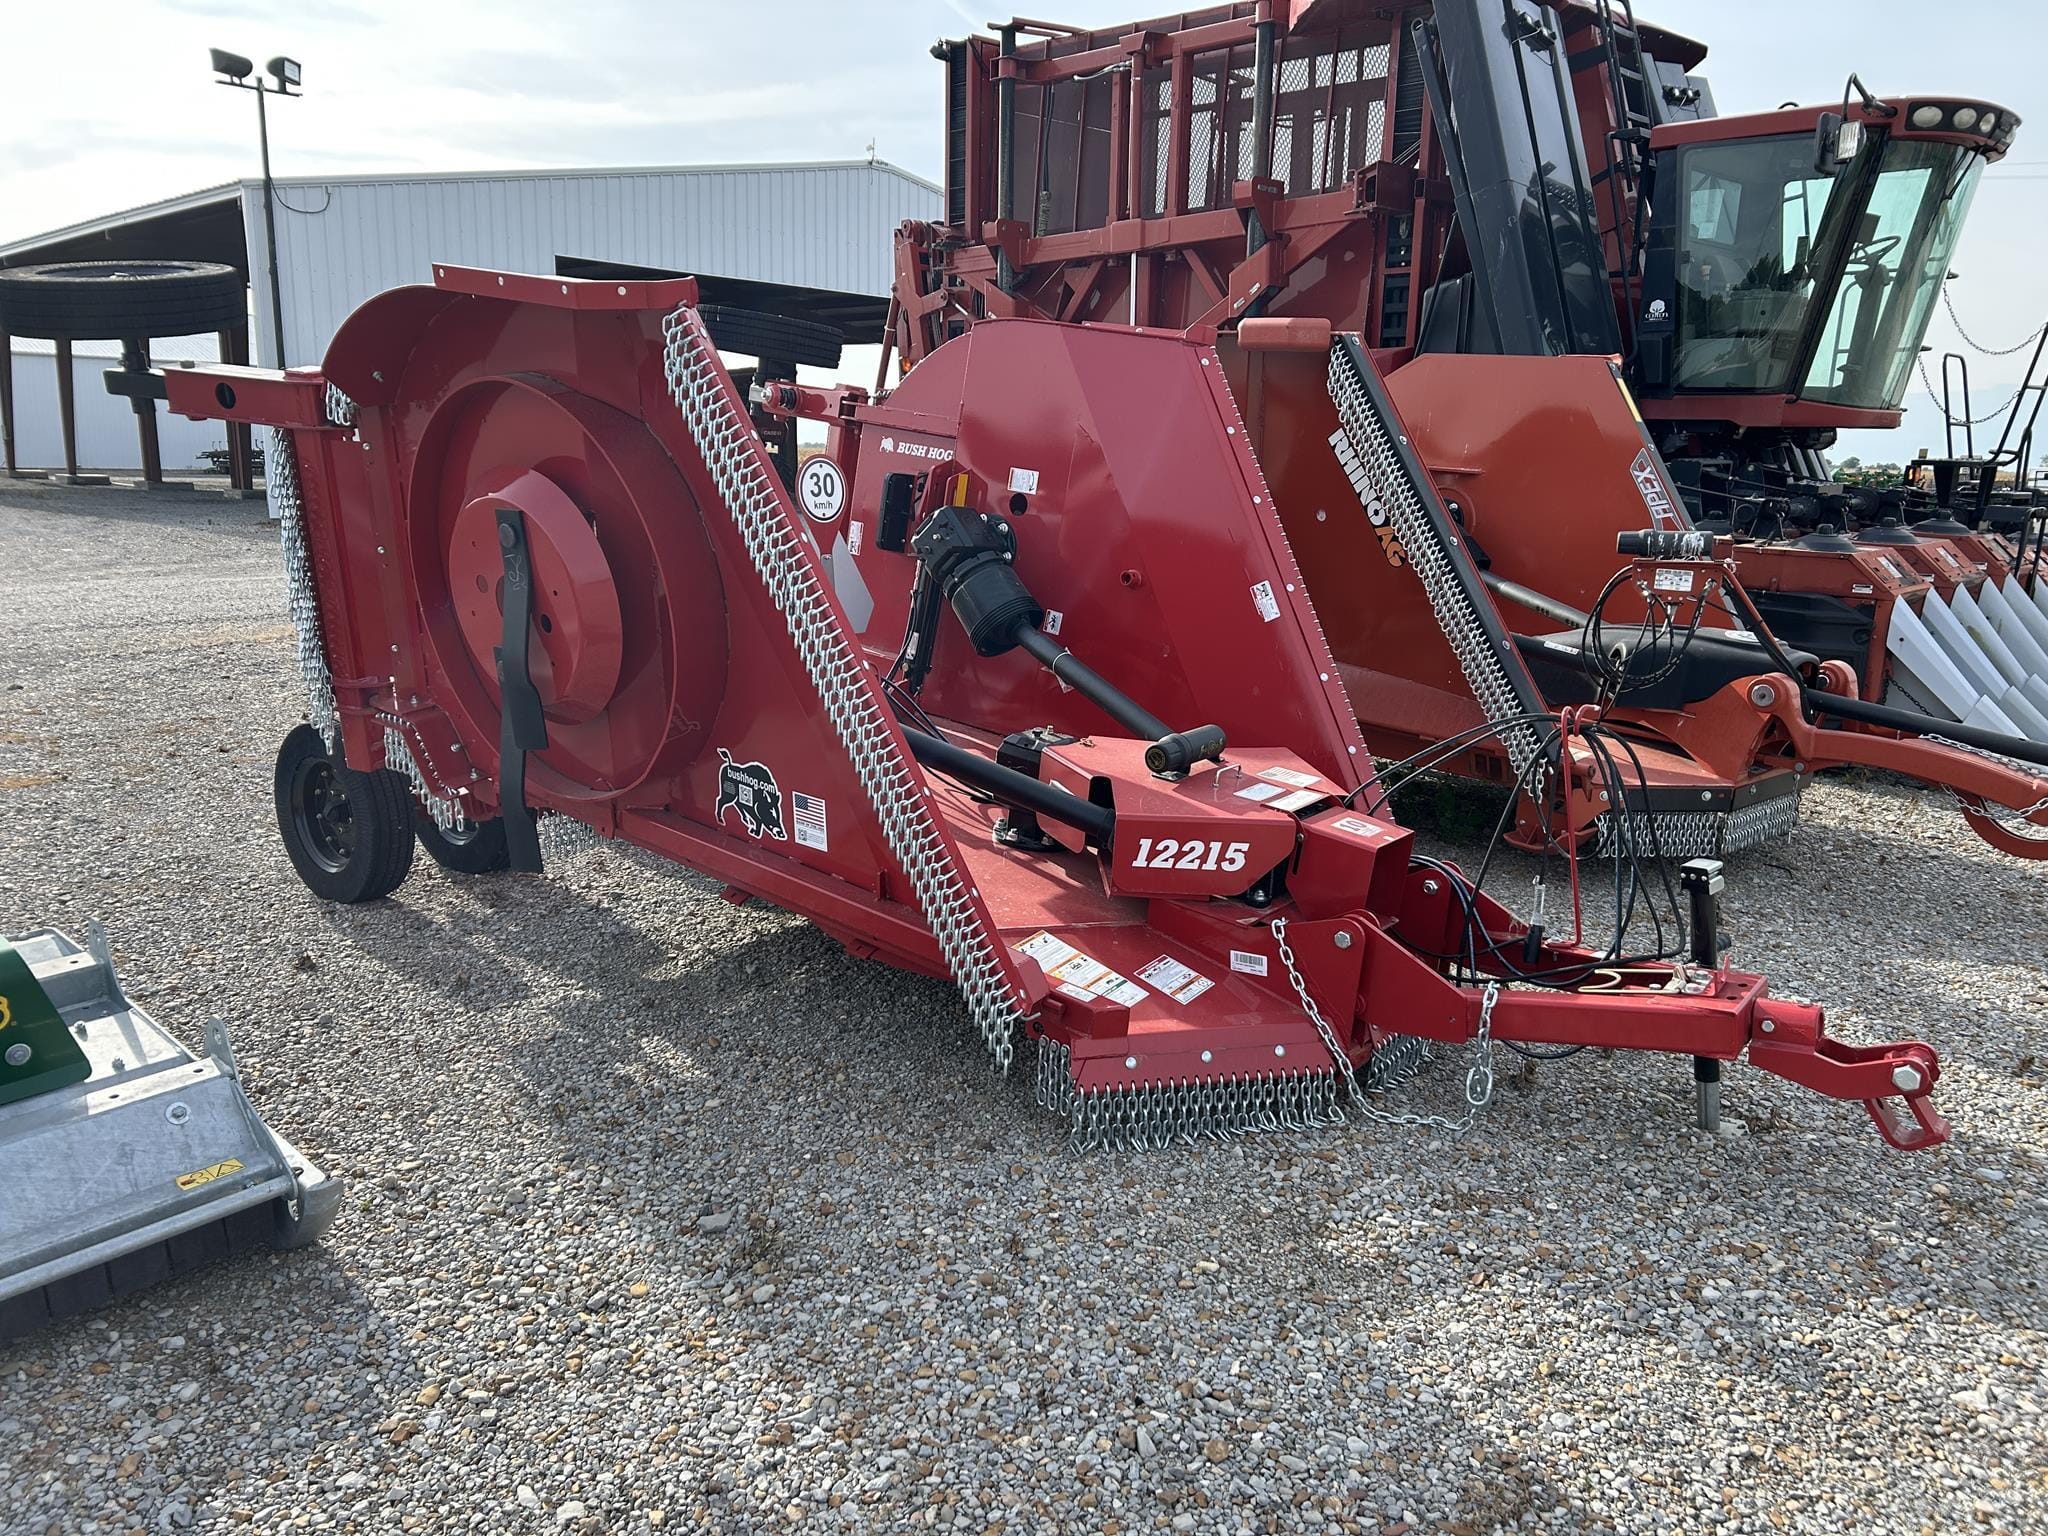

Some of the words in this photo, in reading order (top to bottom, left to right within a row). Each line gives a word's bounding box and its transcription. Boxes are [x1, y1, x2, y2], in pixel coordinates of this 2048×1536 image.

[897, 441, 928, 457] BUSH
[927, 446, 954, 462] HOG
[809, 472, 835, 498] 30
[1327, 427, 1386, 526] RHINO
[813, 500, 833, 510] km/h
[1633, 464, 1674, 519] APEX
[727, 766, 776, 794] bushhog.com
[1131, 838, 1250, 872] 12215
